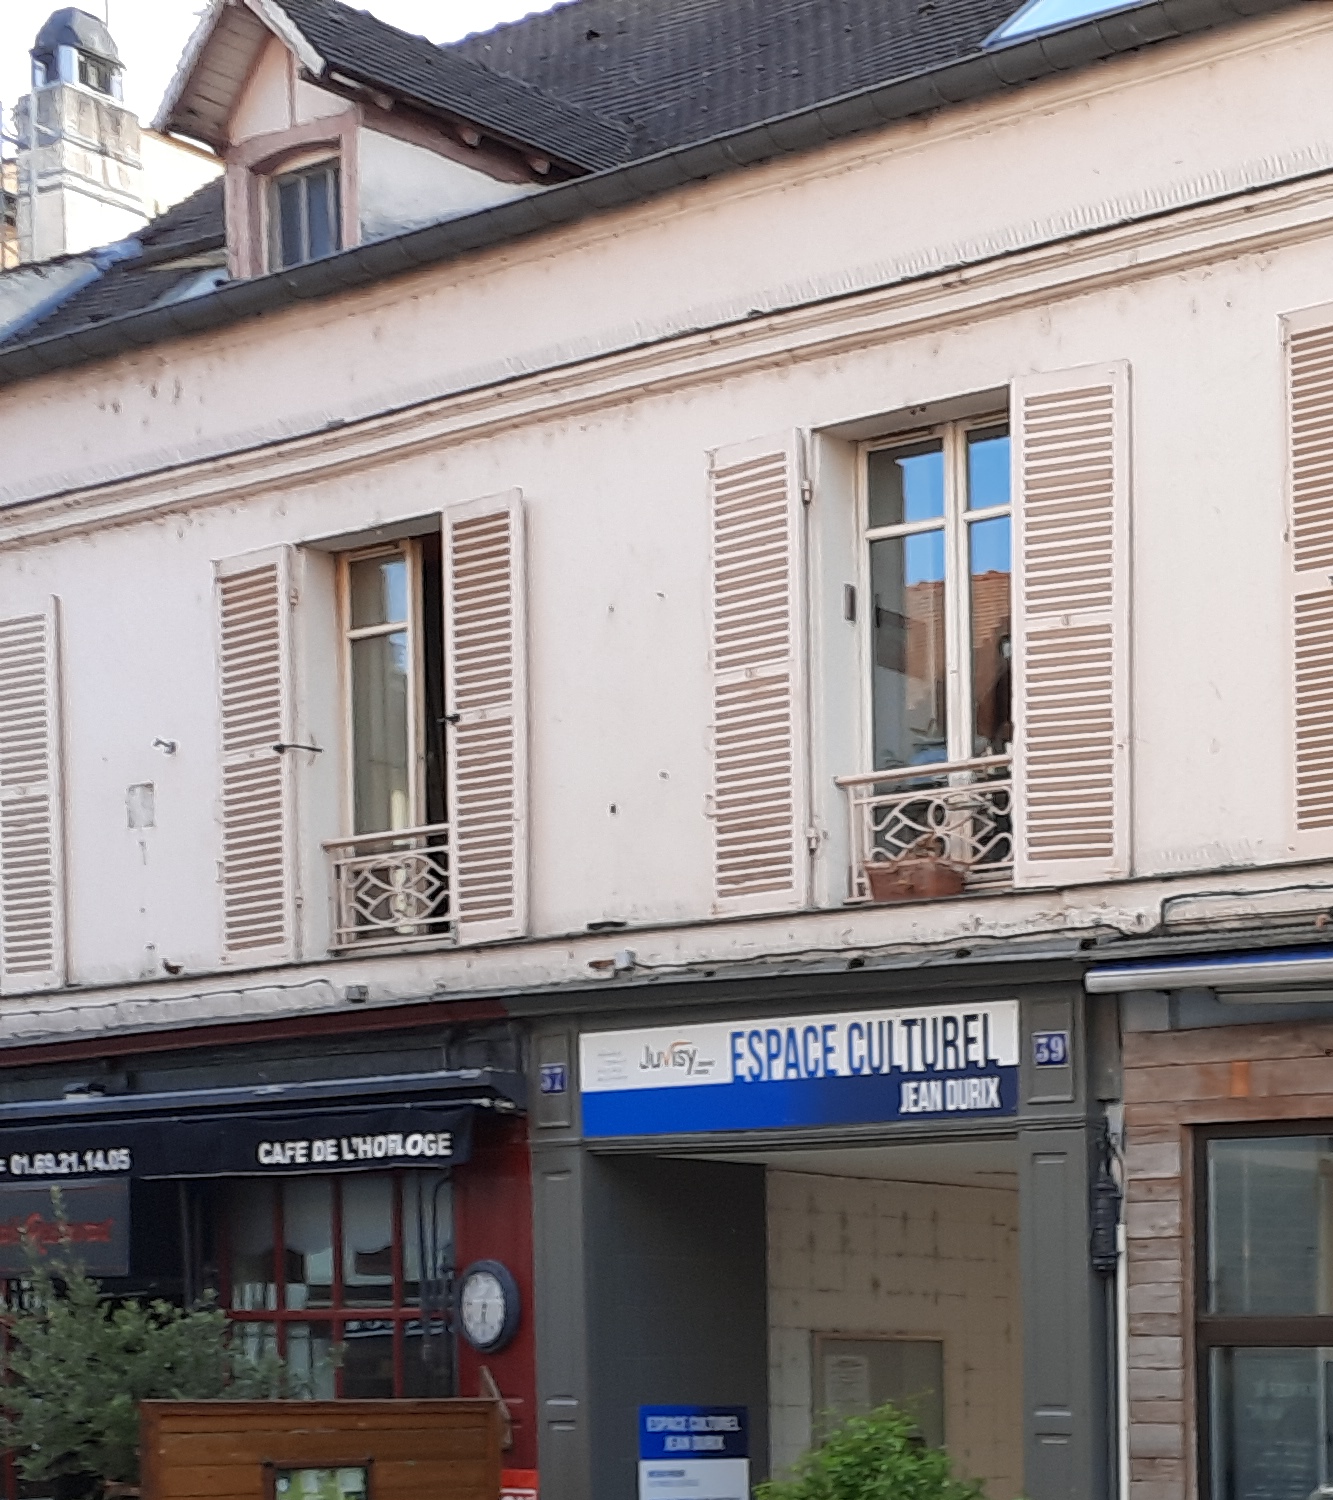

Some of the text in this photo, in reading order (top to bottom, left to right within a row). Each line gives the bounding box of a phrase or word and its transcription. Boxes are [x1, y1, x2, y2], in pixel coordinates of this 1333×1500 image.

[639, 1040, 698, 1076] Juvisy
[730, 1013, 999, 1083] ESPACE CULTUREL
[900, 1076, 1001, 1114] JEAN DURIX
[258, 1140, 308, 1164] CAFE
[311, 1138, 339, 1162] DE
